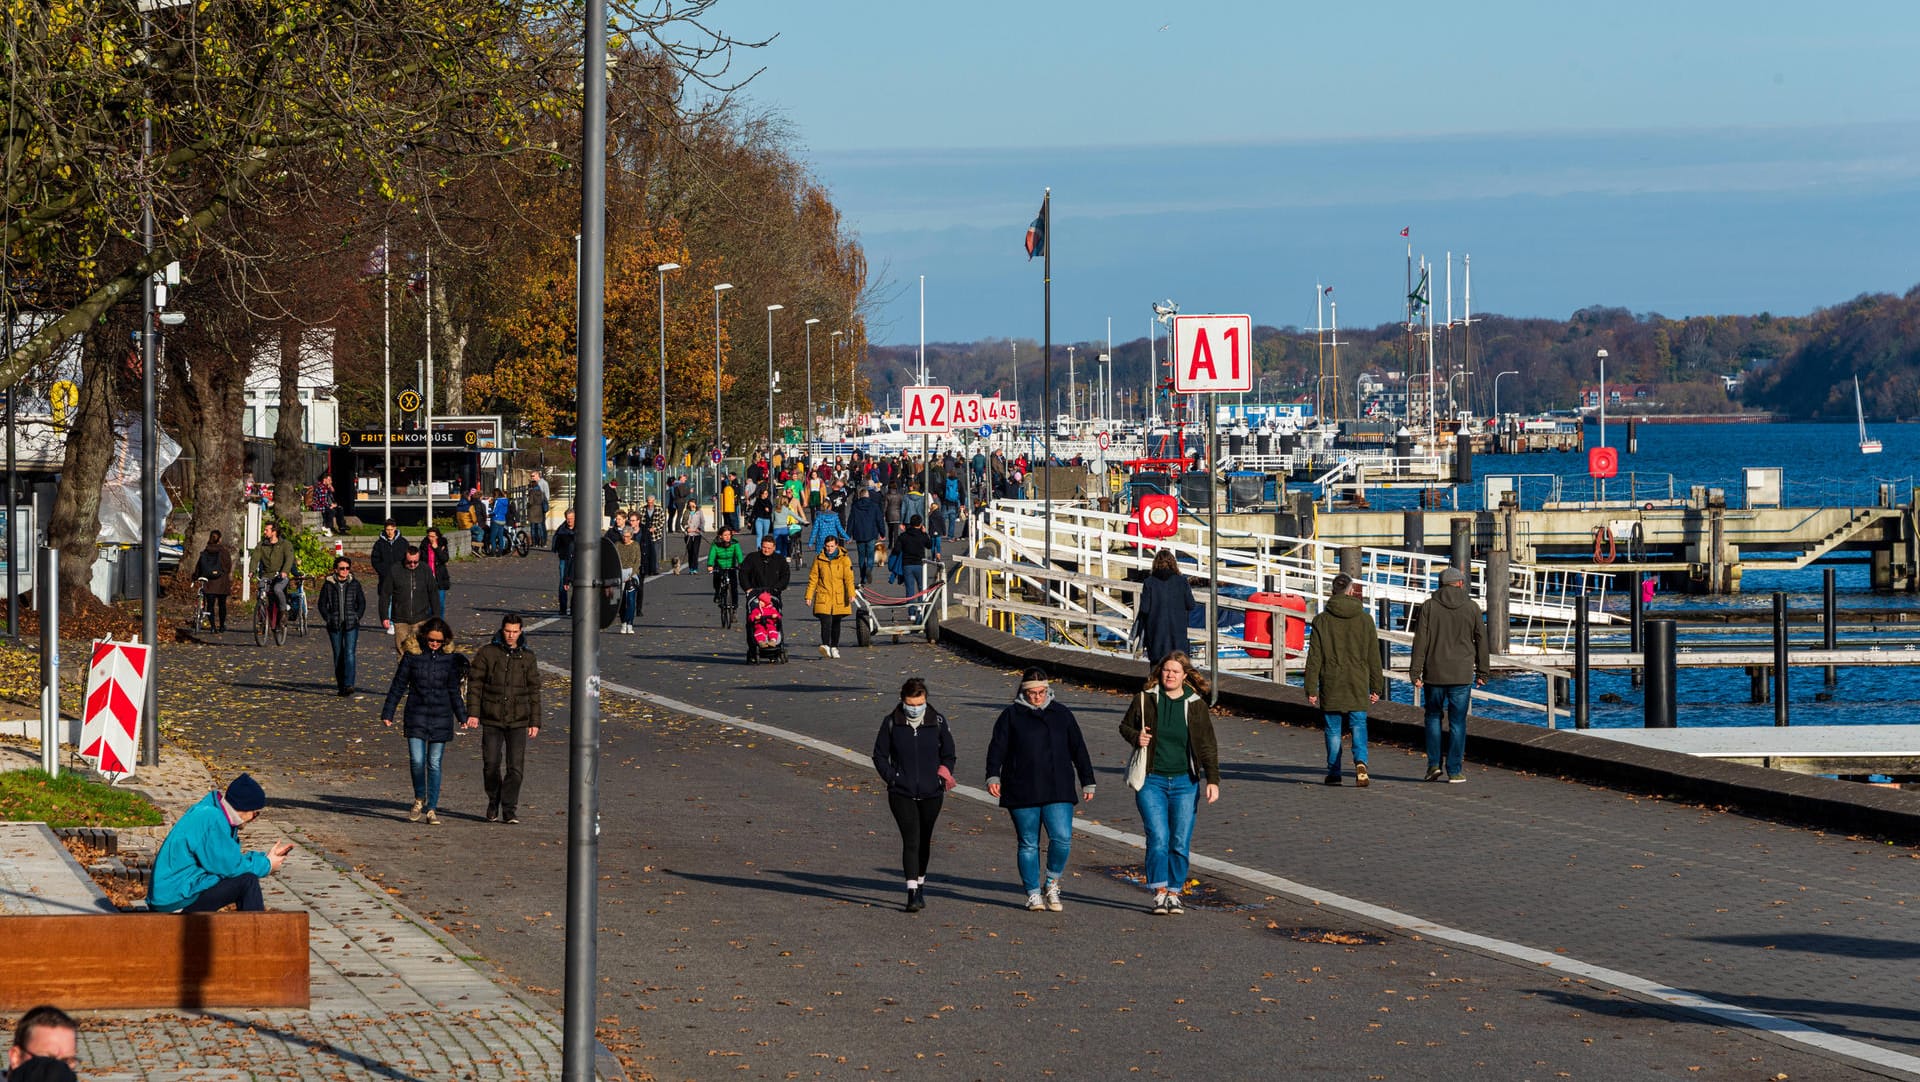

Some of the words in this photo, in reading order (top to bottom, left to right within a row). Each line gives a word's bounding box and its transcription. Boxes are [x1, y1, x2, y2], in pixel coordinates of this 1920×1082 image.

[1188, 327, 1240, 380] A1
[908, 394, 945, 427] A2
[953, 400, 978, 423] A3
[1001, 404, 1016, 420] A5
